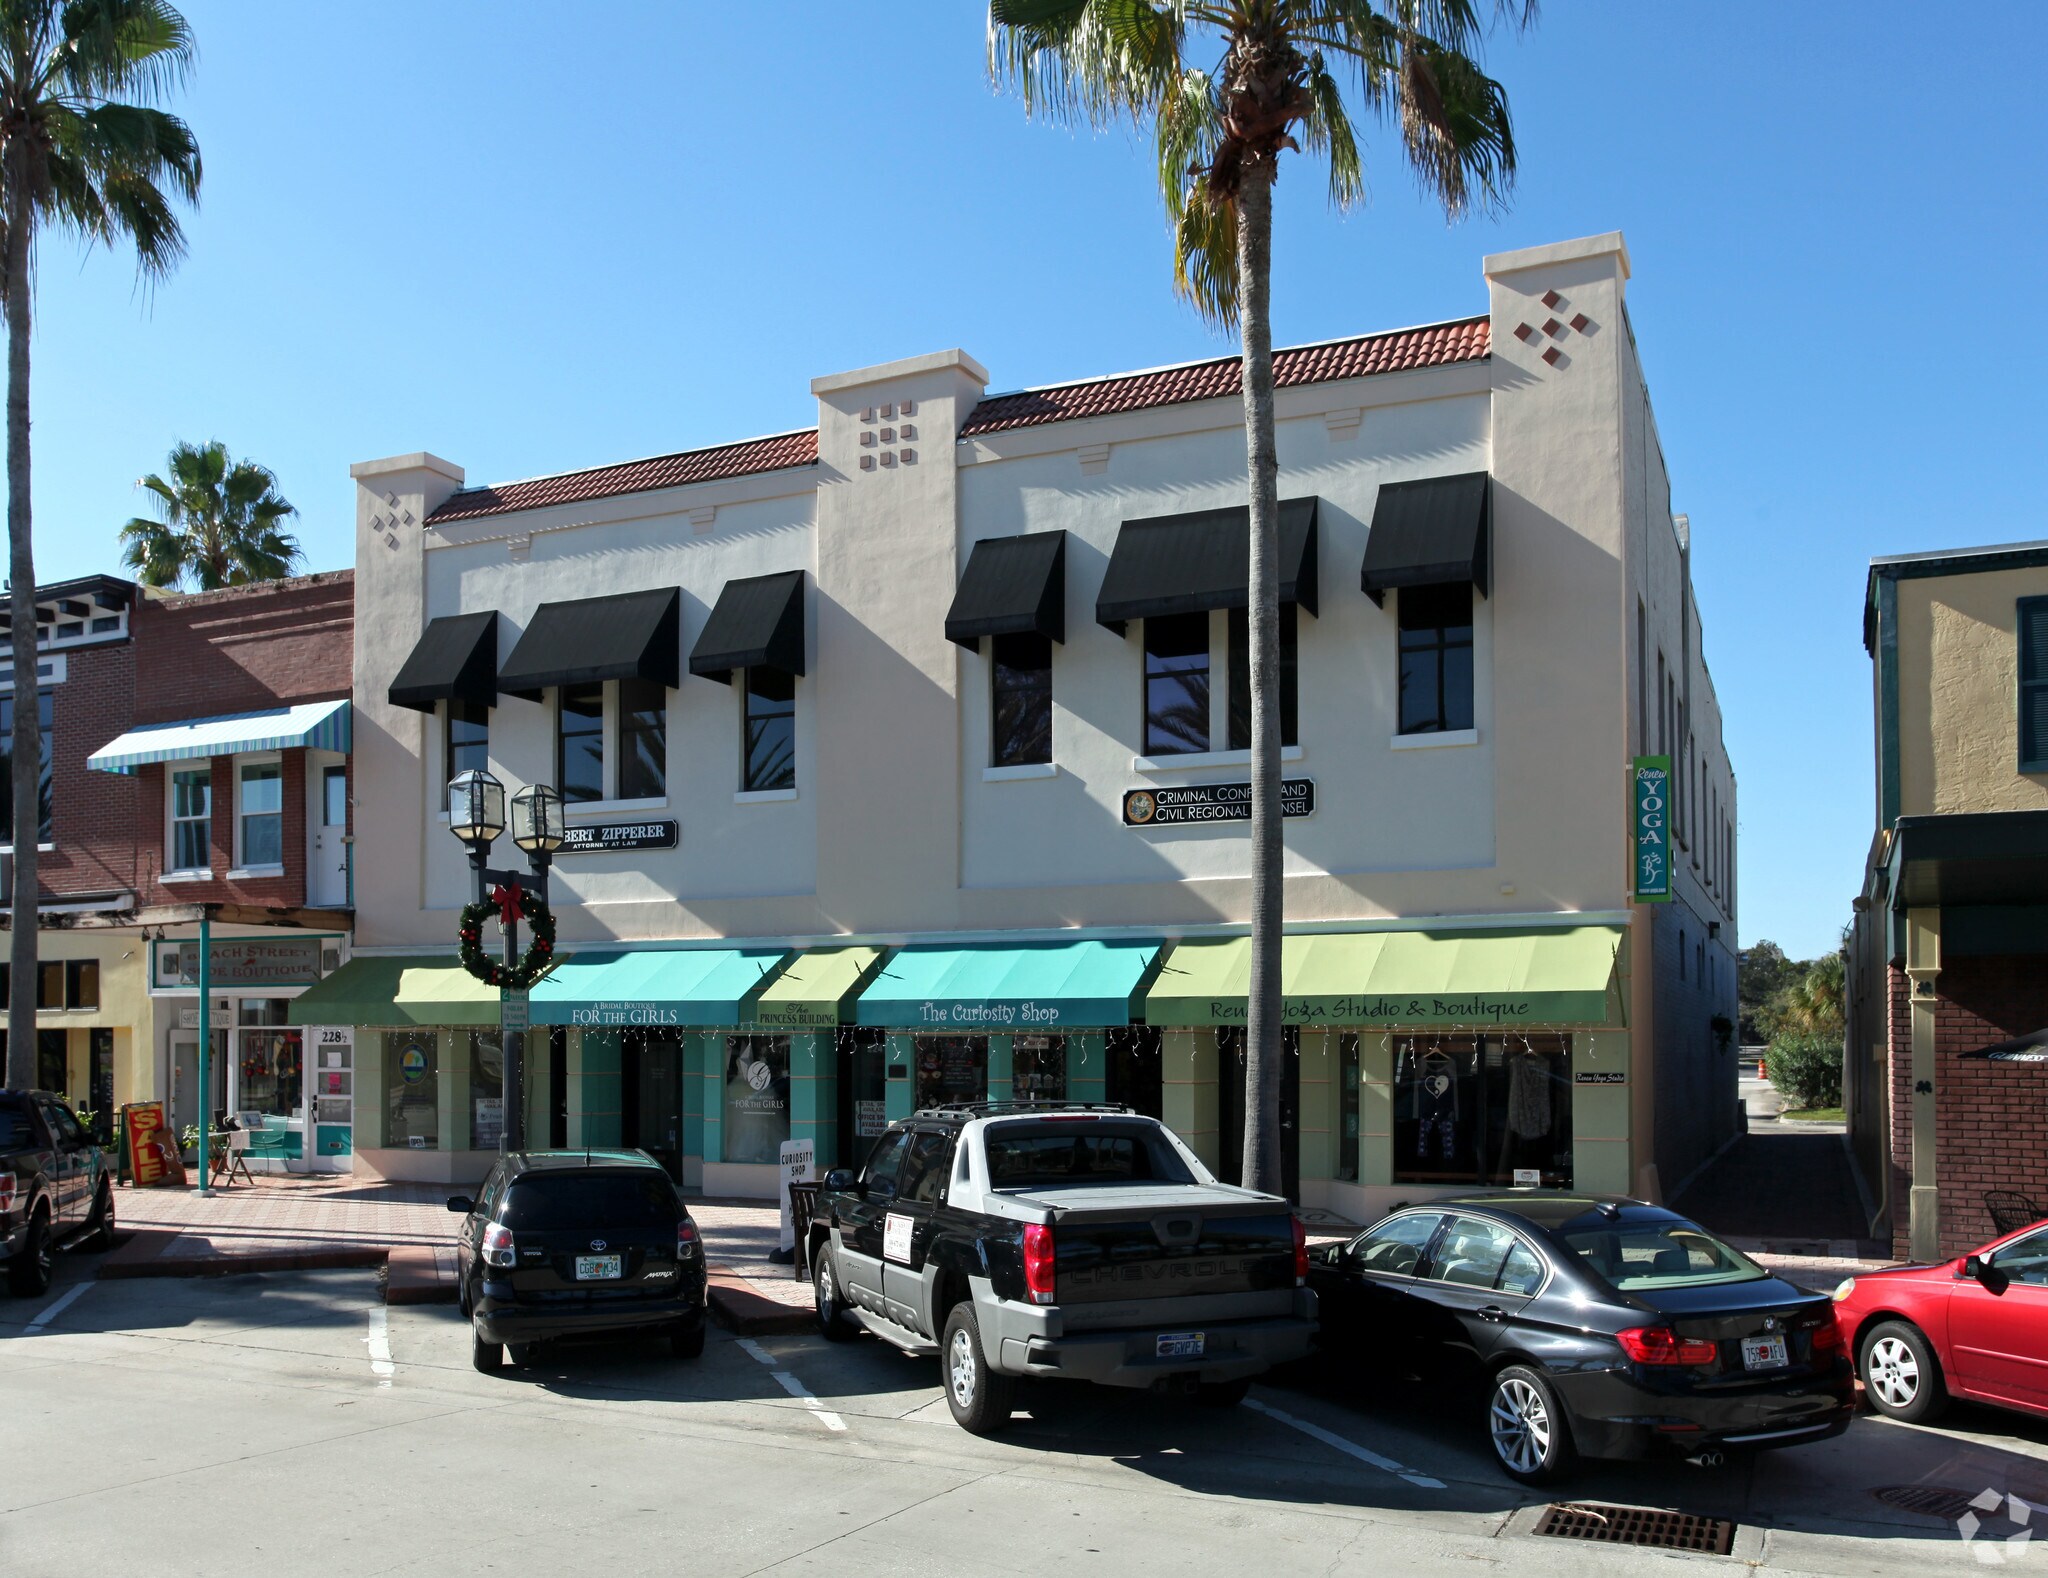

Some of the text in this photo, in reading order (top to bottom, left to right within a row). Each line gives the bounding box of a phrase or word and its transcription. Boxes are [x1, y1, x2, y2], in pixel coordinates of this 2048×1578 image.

[1636, 767, 1667, 780] Renew
[1157, 784, 1307, 804] CRIMINAL CONF AND
[1156, 801, 1308, 821] CIVIL REGIONAL NSEL
[1640, 780, 1662, 844] YOGA
[602, 824, 665, 840] ZIPPERER
[573, 841, 609, 849] ATTORNEY
[187, 946, 311, 961] BACH STREET
[187, 964, 313, 978] SOE BOUTIQUE
[503, 988, 509, 1000] 2
[600, 1001, 621, 1009] BRIDAL
[624, 1001, 657, 1010] BOUTIQUE
[786, 1003, 809, 1014] The
[920, 1001, 1059, 1024] The Curiosity Shop
[1211, 1002, 1249, 1018] Ren
[1332, 997, 1400, 1018] Studio
[1406, 1000, 1426, 1016] &
[1432, 995, 1529, 1023] Boutique
[209, 1013, 230, 1026] TIQUE
[572, 1009, 678, 1023] FOR THE GIRLS
[760, 1013, 835, 1024] PRINCESS BUILDING
[735, 1100, 750, 1108] FOR
[763, 1100, 784, 1108] GIRLS
[134, 1112, 162, 1183] SALE
[782, 1152, 813, 1165] CURIOSITY
[791, 1165, 806, 1176] SHOP
[1070, 1258, 1262, 1284] CHEVROLE
